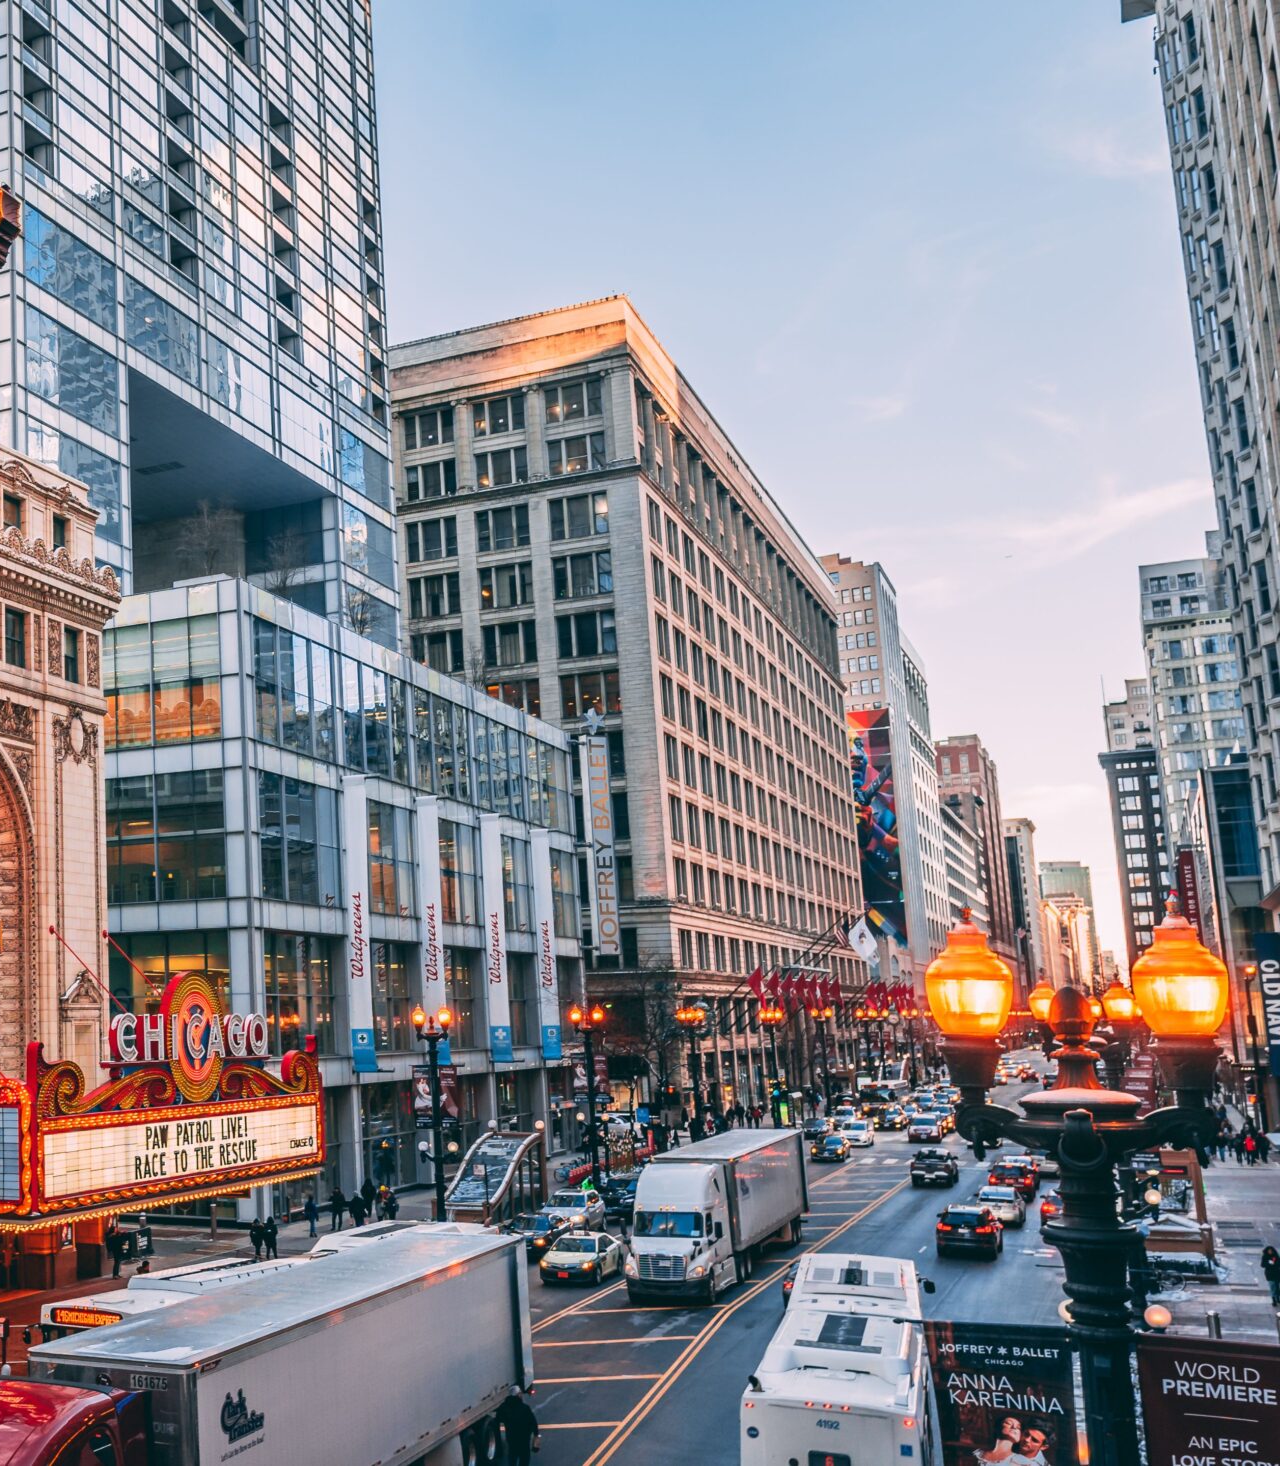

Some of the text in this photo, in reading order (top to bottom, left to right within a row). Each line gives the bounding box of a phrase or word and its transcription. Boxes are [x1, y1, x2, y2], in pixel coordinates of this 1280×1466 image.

[588, 738, 619, 951] JOFFREY BALLET
[1184, 865, 1194, 888] STATE
[349, 891, 368, 980] Walgreens
[424, 902, 442, 983] Walgreens
[488, 911, 505, 985] Walgreens
[539, 920, 556, 989] Walgreens
[1260, 959, 1280, 996] OLD
[115, 1011, 269, 1062] CHICAGO
[145, 1116, 249, 1151] PAW PATROL LIVE!
[289, 1138, 309, 1149] CHASE
[134, 1139, 258, 1180] RACE TO THE RESCUE
[939, 1343, 1060, 1359] JOFFREY BALLET
[984, 1358, 1024, 1367] CHICAGO
[131, 1375, 168, 1390] 161675
[946, 1372, 1014, 1393] ANNA
[1174, 1360, 1261, 1384] WORLD
[948, 1388, 1065, 1415] KARENINA
[1162, 1378, 1278, 1406] PREMIERE
[816, 1418, 841, 1431] 4192
[1188, 1435, 1259, 1454] AN EPIC
